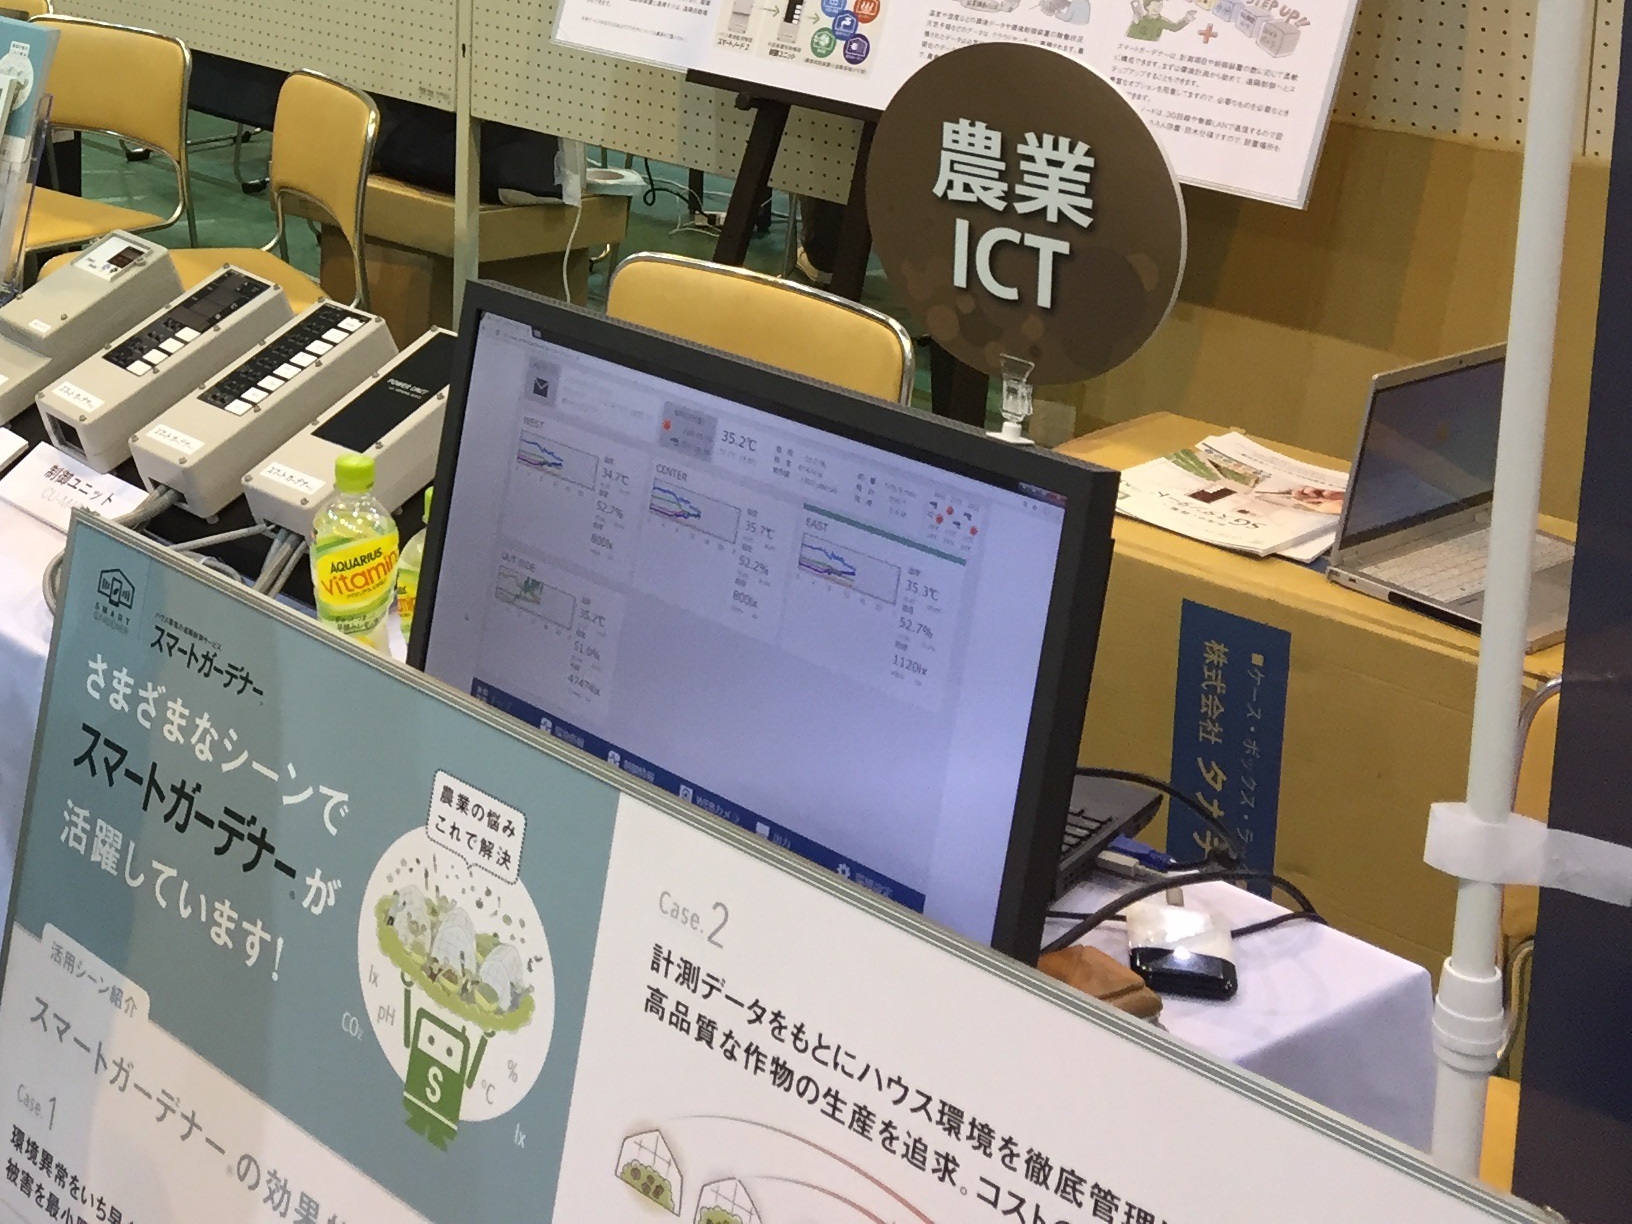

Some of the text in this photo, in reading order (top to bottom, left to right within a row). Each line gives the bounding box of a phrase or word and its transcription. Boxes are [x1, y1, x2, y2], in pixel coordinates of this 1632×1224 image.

[932, 117, 1096, 229] 農業
[953, 217, 1071, 310] ICT
[44, 463, 115, 506] 制御ユニット
[320, 550, 398, 596] vitamin
[330, 547, 384, 574] AQUARIUS
[94, 601, 131, 626] SMART
[150, 625, 264, 696] スマートガーデナー
[1197, 639, 1232, 745] 株式会社
[86, 653, 350, 837] さまざまなシーンで
[434, 814, 512, 871] これで解決
[439, 784, 517, 839] 農業の悩み
[60, 797, 285, 982] 活躍しています!
[49, 940, 138, 1019] 活用シーン紹介
[376, 1004, 397, 1027] pH
[425, 1065, 444, 1104] S
[643, 984, 1071, 1224] 高品質な作物の生産を追求。コスト
[651, 943, 1168, 1224] 計測データをもとにハウス環境を徹底管理
[9, 1123, 135, 1224] 環境異常をいち早
